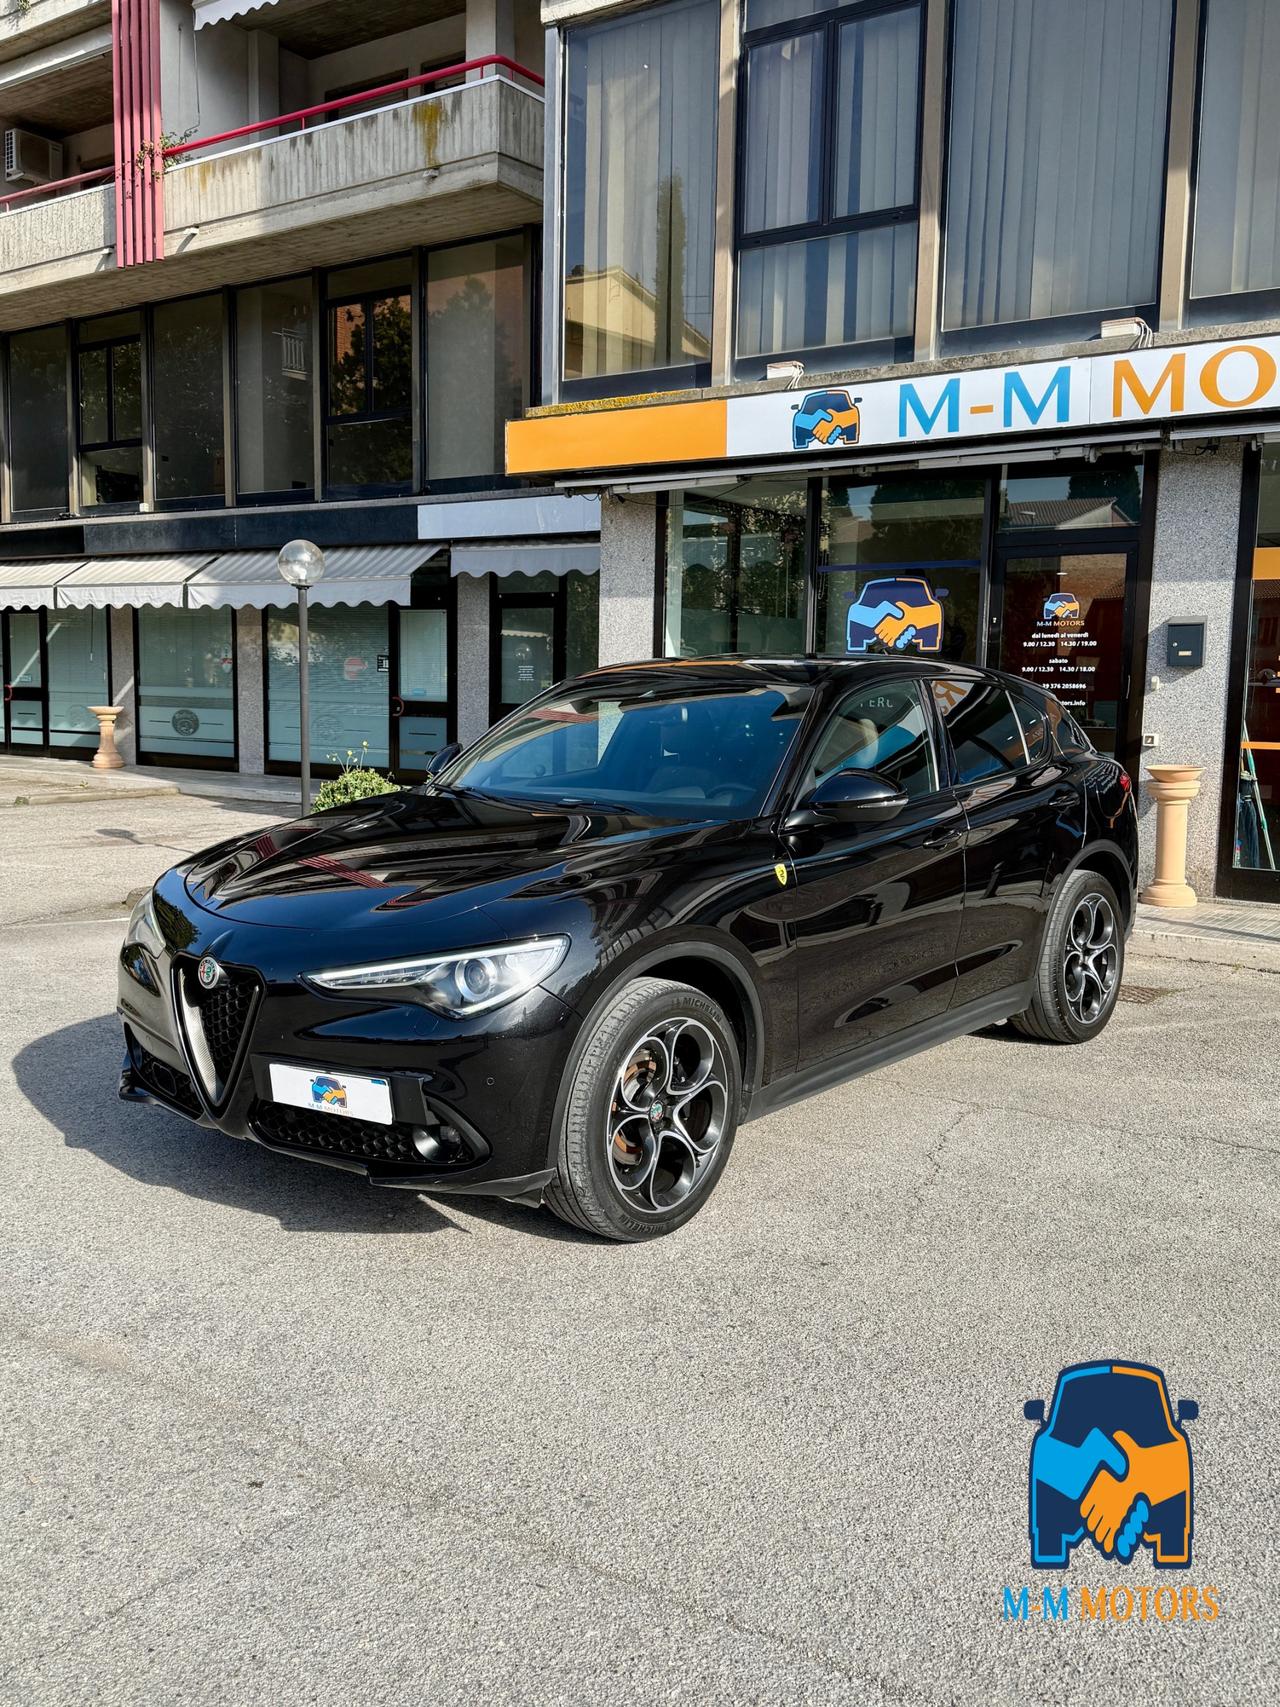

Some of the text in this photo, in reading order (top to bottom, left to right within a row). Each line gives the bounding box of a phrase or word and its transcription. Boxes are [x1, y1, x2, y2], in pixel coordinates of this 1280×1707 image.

[899, 345, 1278, 438] M-M MO
[683, 997, 722, 1023] MICHELIN
[618, 1214, 664, 1233] MICHELIN
